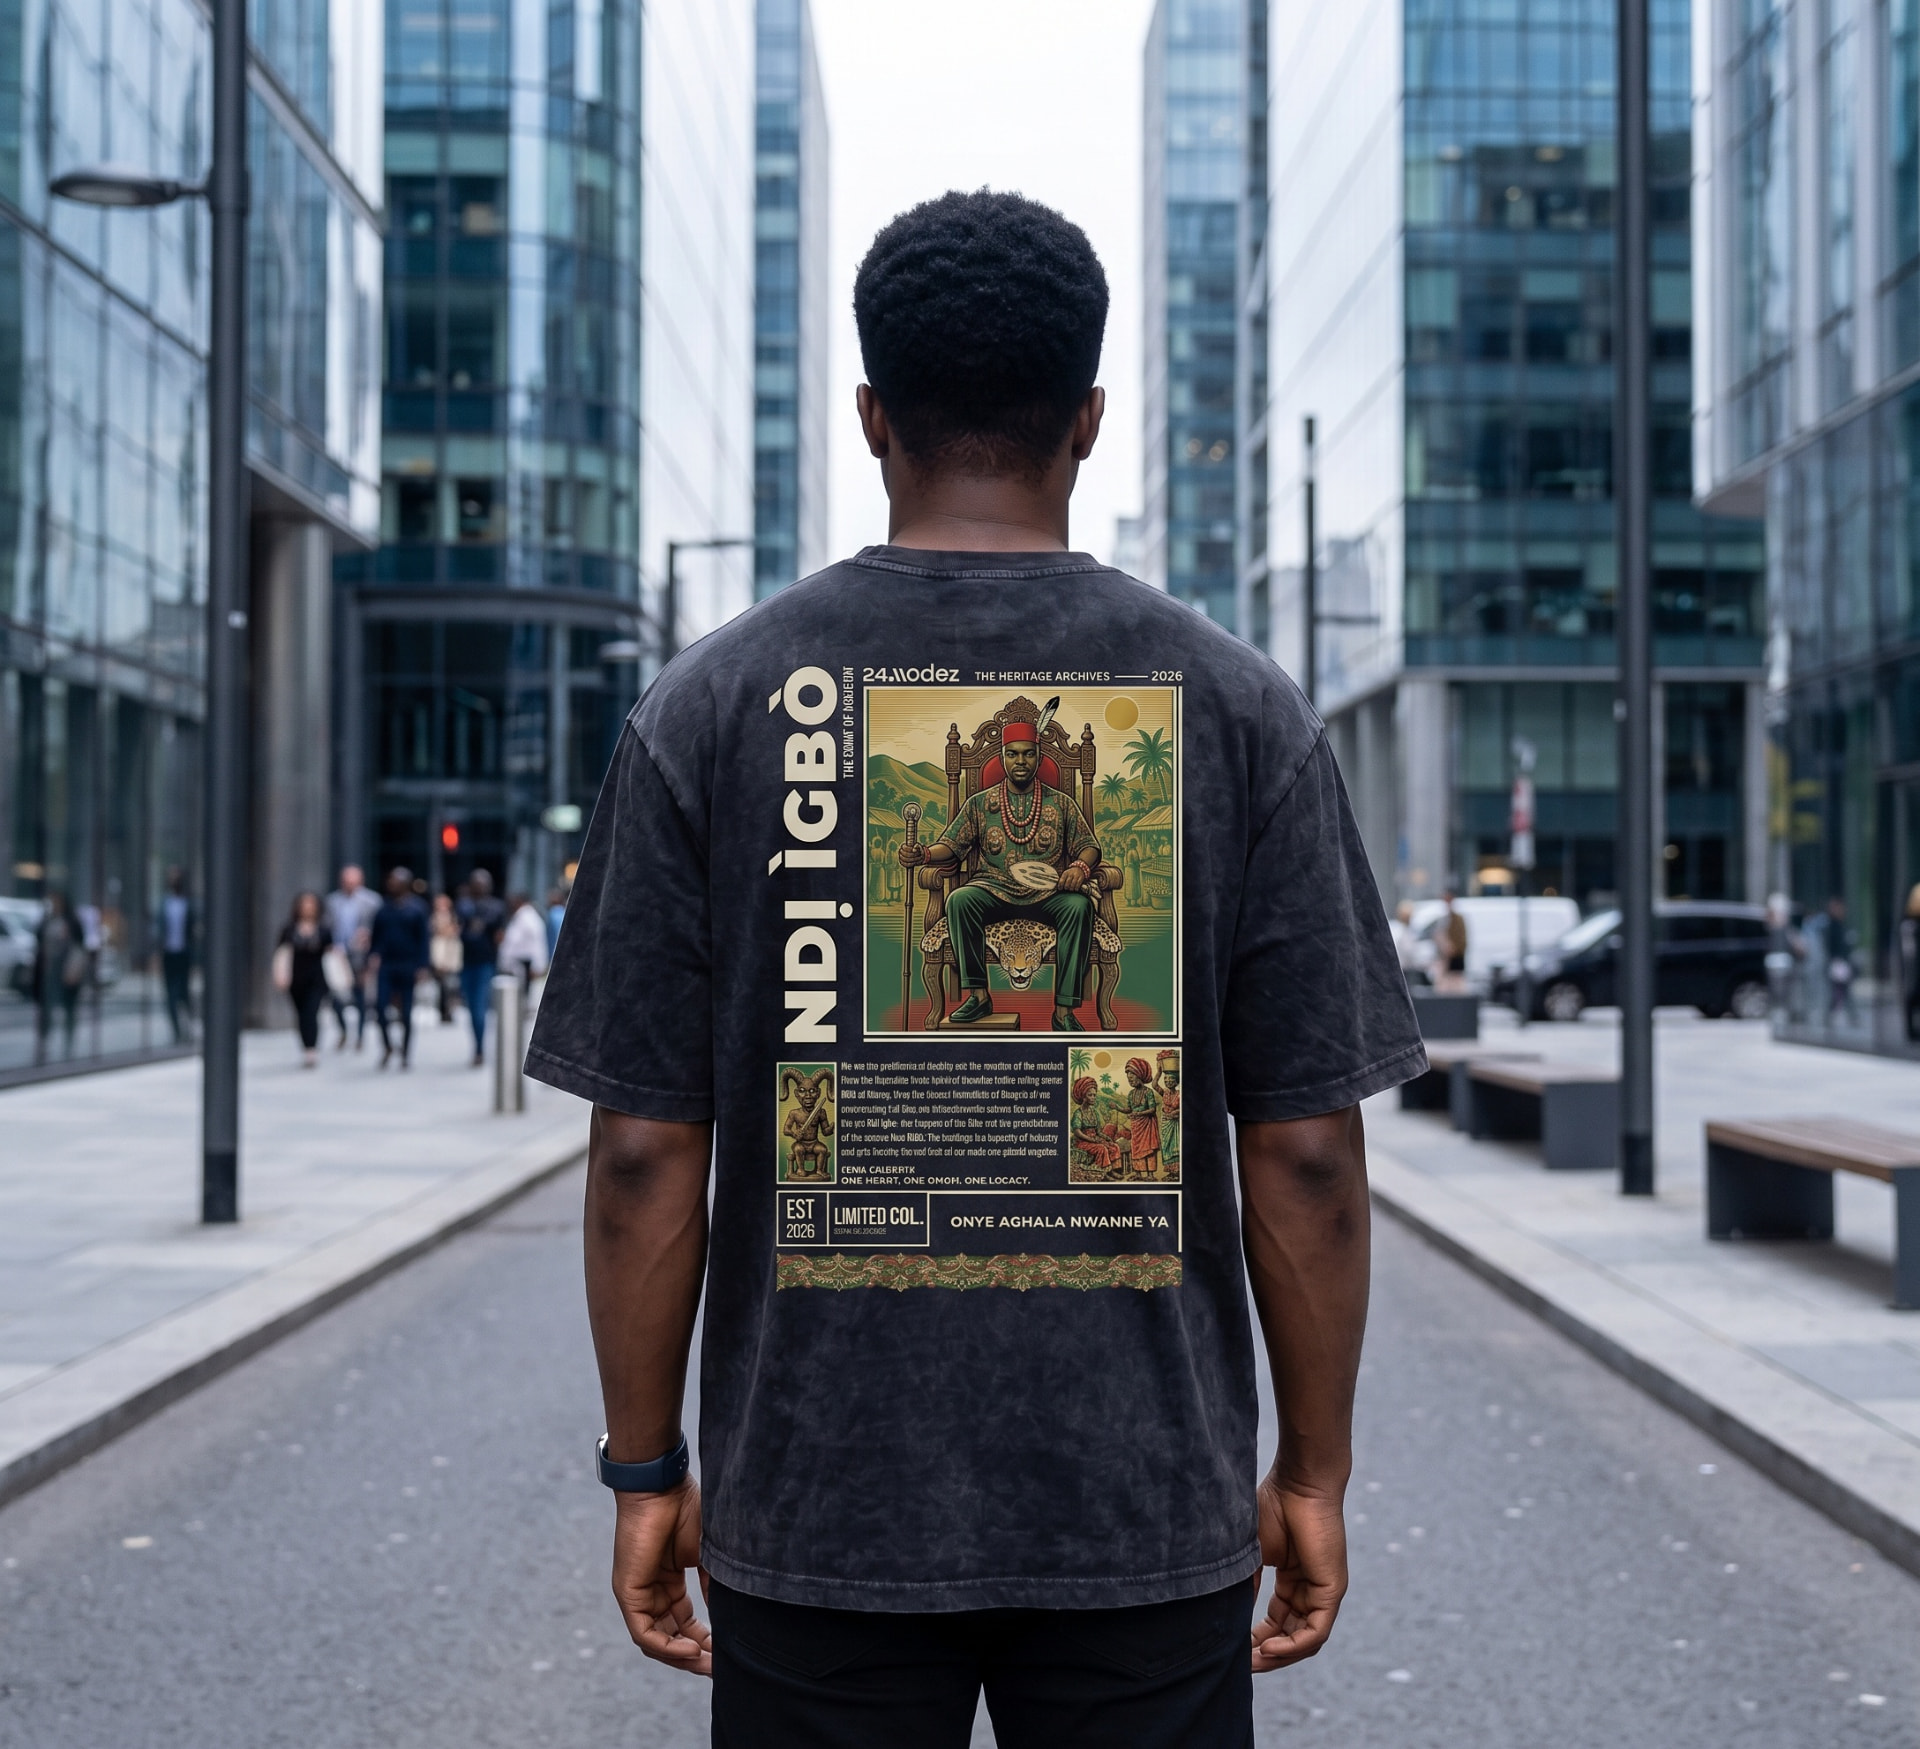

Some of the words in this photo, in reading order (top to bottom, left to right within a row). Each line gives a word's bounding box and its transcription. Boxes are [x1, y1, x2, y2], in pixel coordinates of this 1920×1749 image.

[975, 672, 995, 680] THE
[999, 672, 1052, 681] HERITAGE
[1055, 672, 1110, 681] ARCHIVES
[1152, 671, 1182, 681] 2026
[843, 714, 853, 726] OF
[843, 754, 853, 778] THE
[787, 1199, 815, 1219] EST
[835, 1207, 886, 1224] LIMITED
[890, 1207, 923, 1224] COL.
[951, 1217, 994, 1227] ONYE
[999, 1217, 1065, 1227] AGHALA
[1071, 1217, 1142, 1227] NWANNE
[1148, 1217, 1168, 1227] YA
[787, 1224, 814, 1238] 2026
